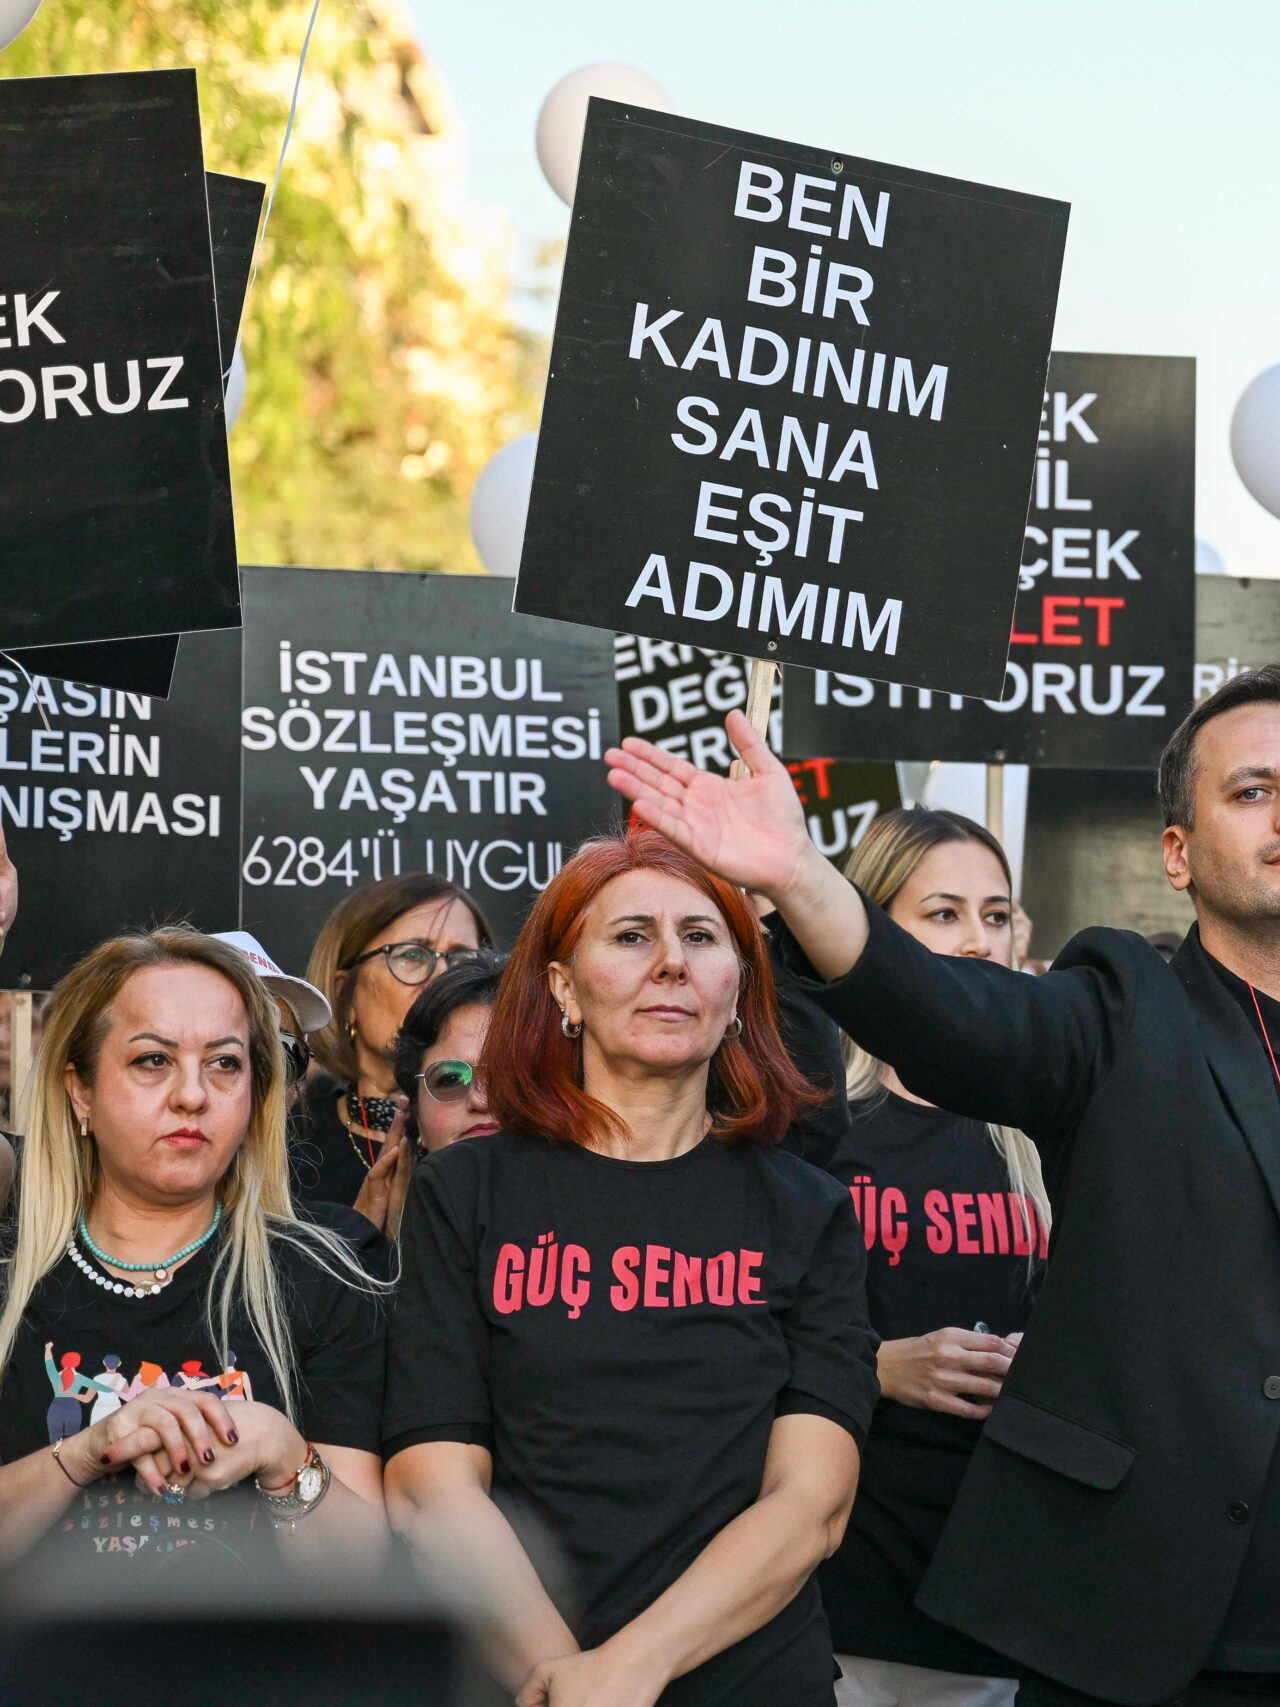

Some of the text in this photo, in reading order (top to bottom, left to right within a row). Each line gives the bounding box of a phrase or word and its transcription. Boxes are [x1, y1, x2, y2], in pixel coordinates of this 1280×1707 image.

[734, 161, 890, 247] BEN
[747, 245, 874, 326] BİR
[628, 302, 948, 421] KADINIM
[670, 395, 879, 490] SANA
[693, 481, 864, 566] EŞİT
[625, 553, 903, 656] ADIMIM
[279, 640, 563, 702] İSTANBUL
[241, 699, 601, 767] SÖZLEŞMESİ
[300, 766, 547, 823] YAŞATIR
[493, 1231, 768, 1319] GÜÇ SENDE
